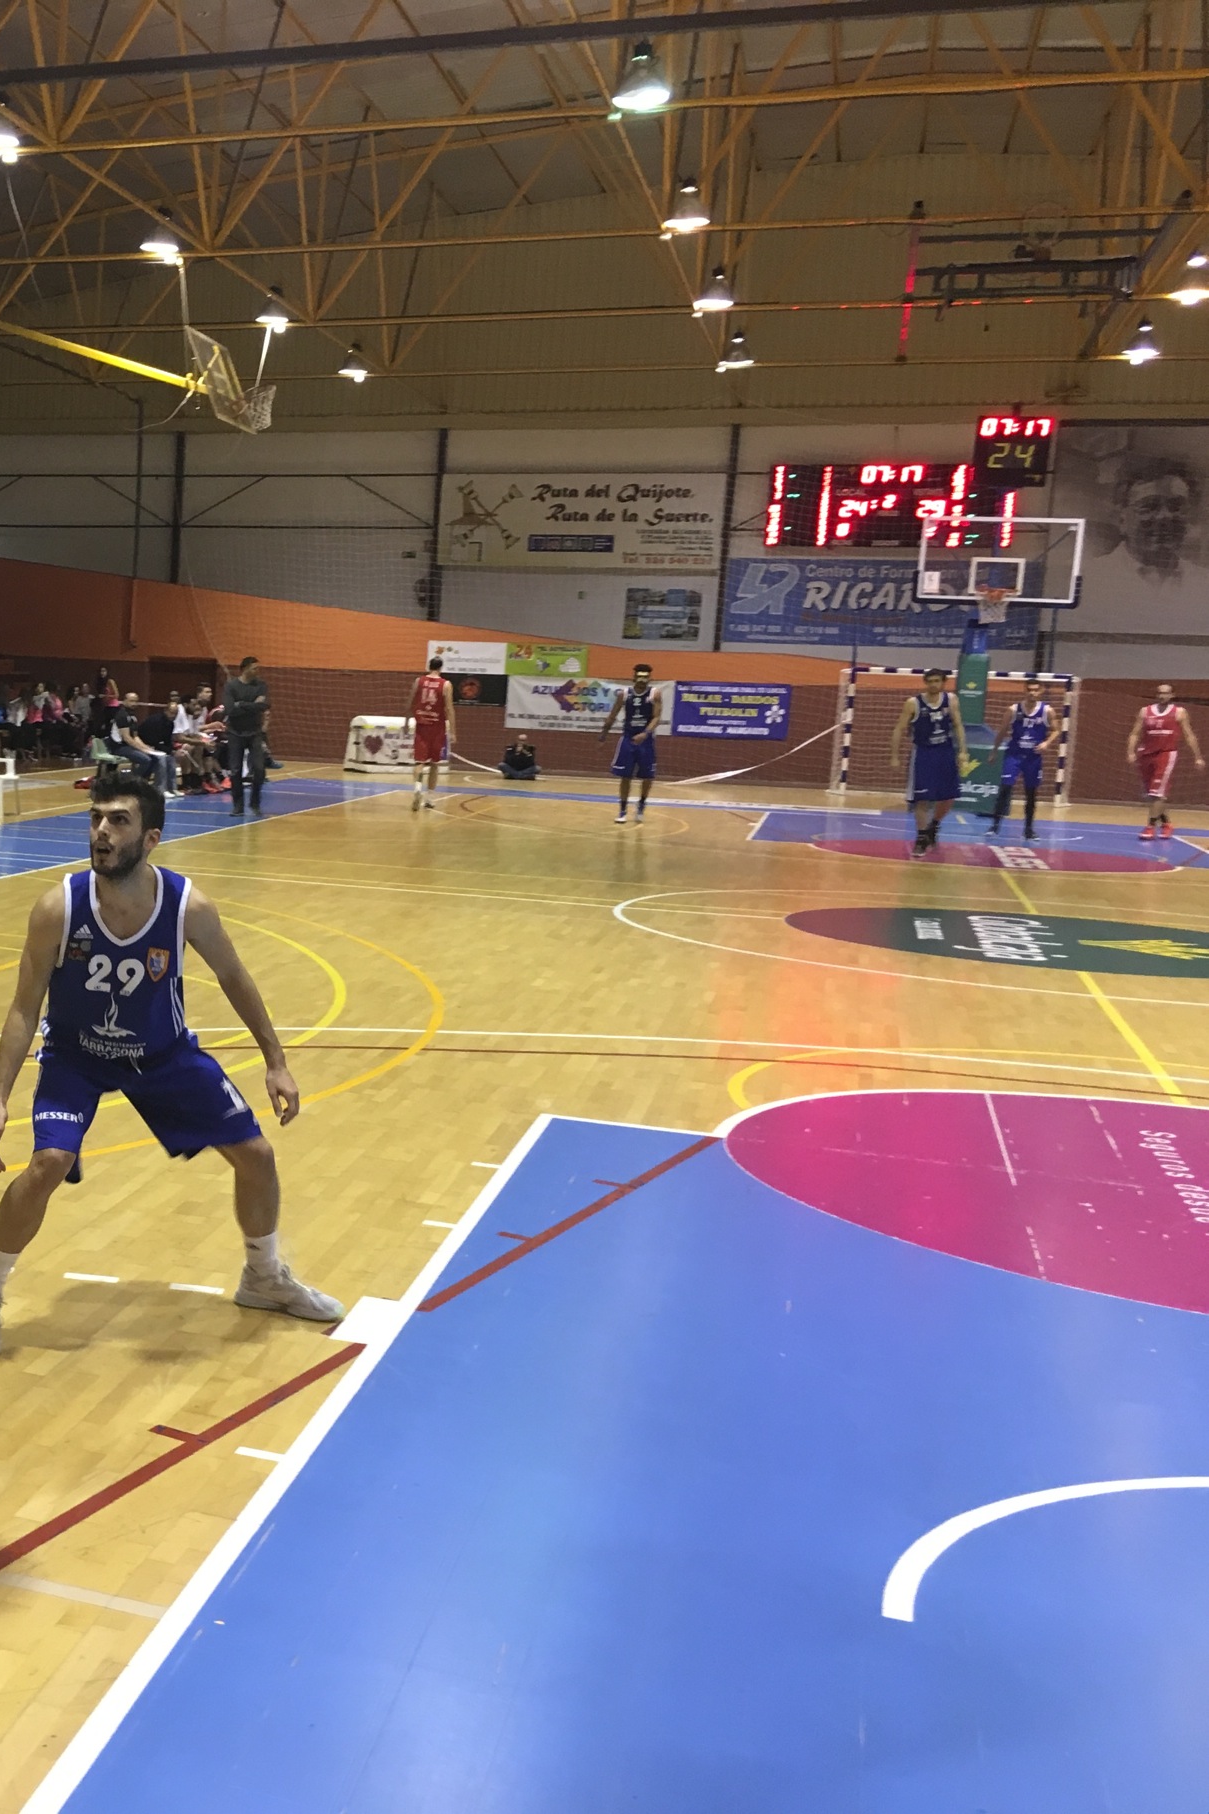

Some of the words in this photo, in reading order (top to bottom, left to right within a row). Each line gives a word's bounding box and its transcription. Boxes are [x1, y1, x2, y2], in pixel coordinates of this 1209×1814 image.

[979, 417, 1052, 437] 07:17
[986, 442, 1036, 468] 24
[860, 464, 924, 484] 07:17
[530, 483, 580, 503] Ruta
[585, 484, 611, 499] del
[545, 503, 590, 523] Ruta
[595, 508, 616, 523] de
[622, 508, 639, 523] la
[804, 563, 855, 579] Centro
[858, 565, 876, 579] de
[85, 954, 146, 997] 29
[78, 1034, 145, 1057] TARRAGONA
[34, 1111, 79, 1123] MESSER
[1138, 1129, 1196, 1179] Seguros
